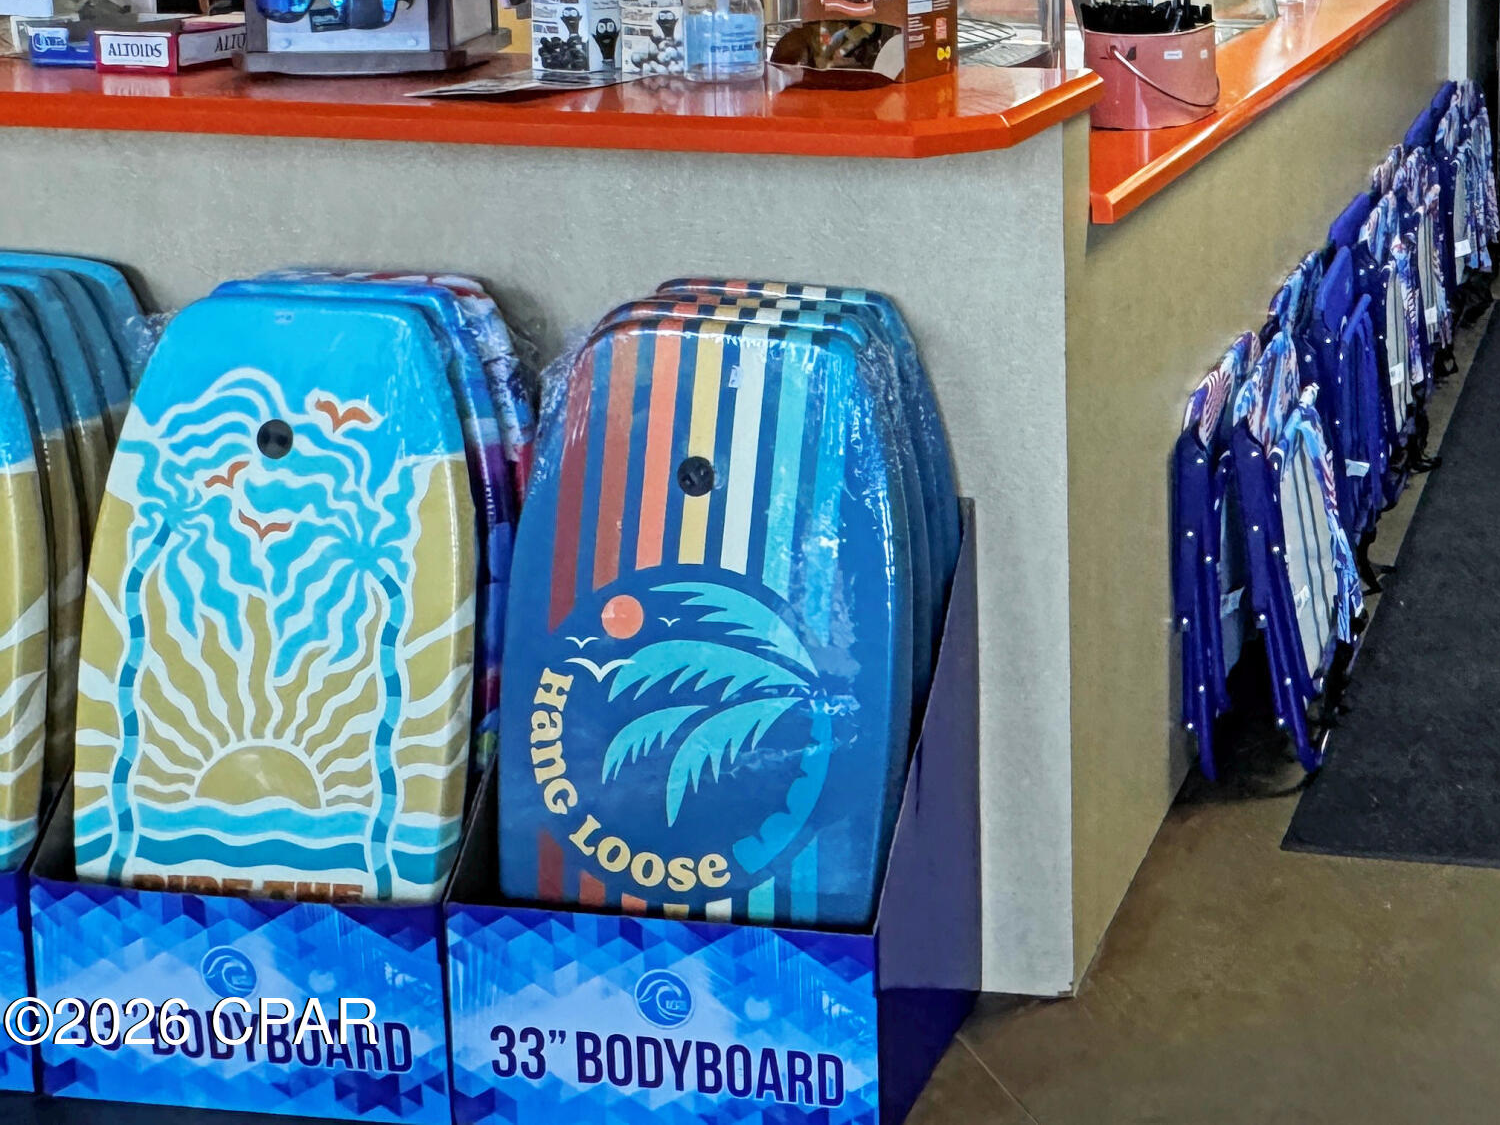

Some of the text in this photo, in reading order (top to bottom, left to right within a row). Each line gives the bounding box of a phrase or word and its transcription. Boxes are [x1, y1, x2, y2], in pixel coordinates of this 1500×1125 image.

[107, 42, 163, 58] ALTOIDS
[151, 1006, 414, 1074] BODYBOARD
[575, 1030, 846, 1109] BODYBOARD
